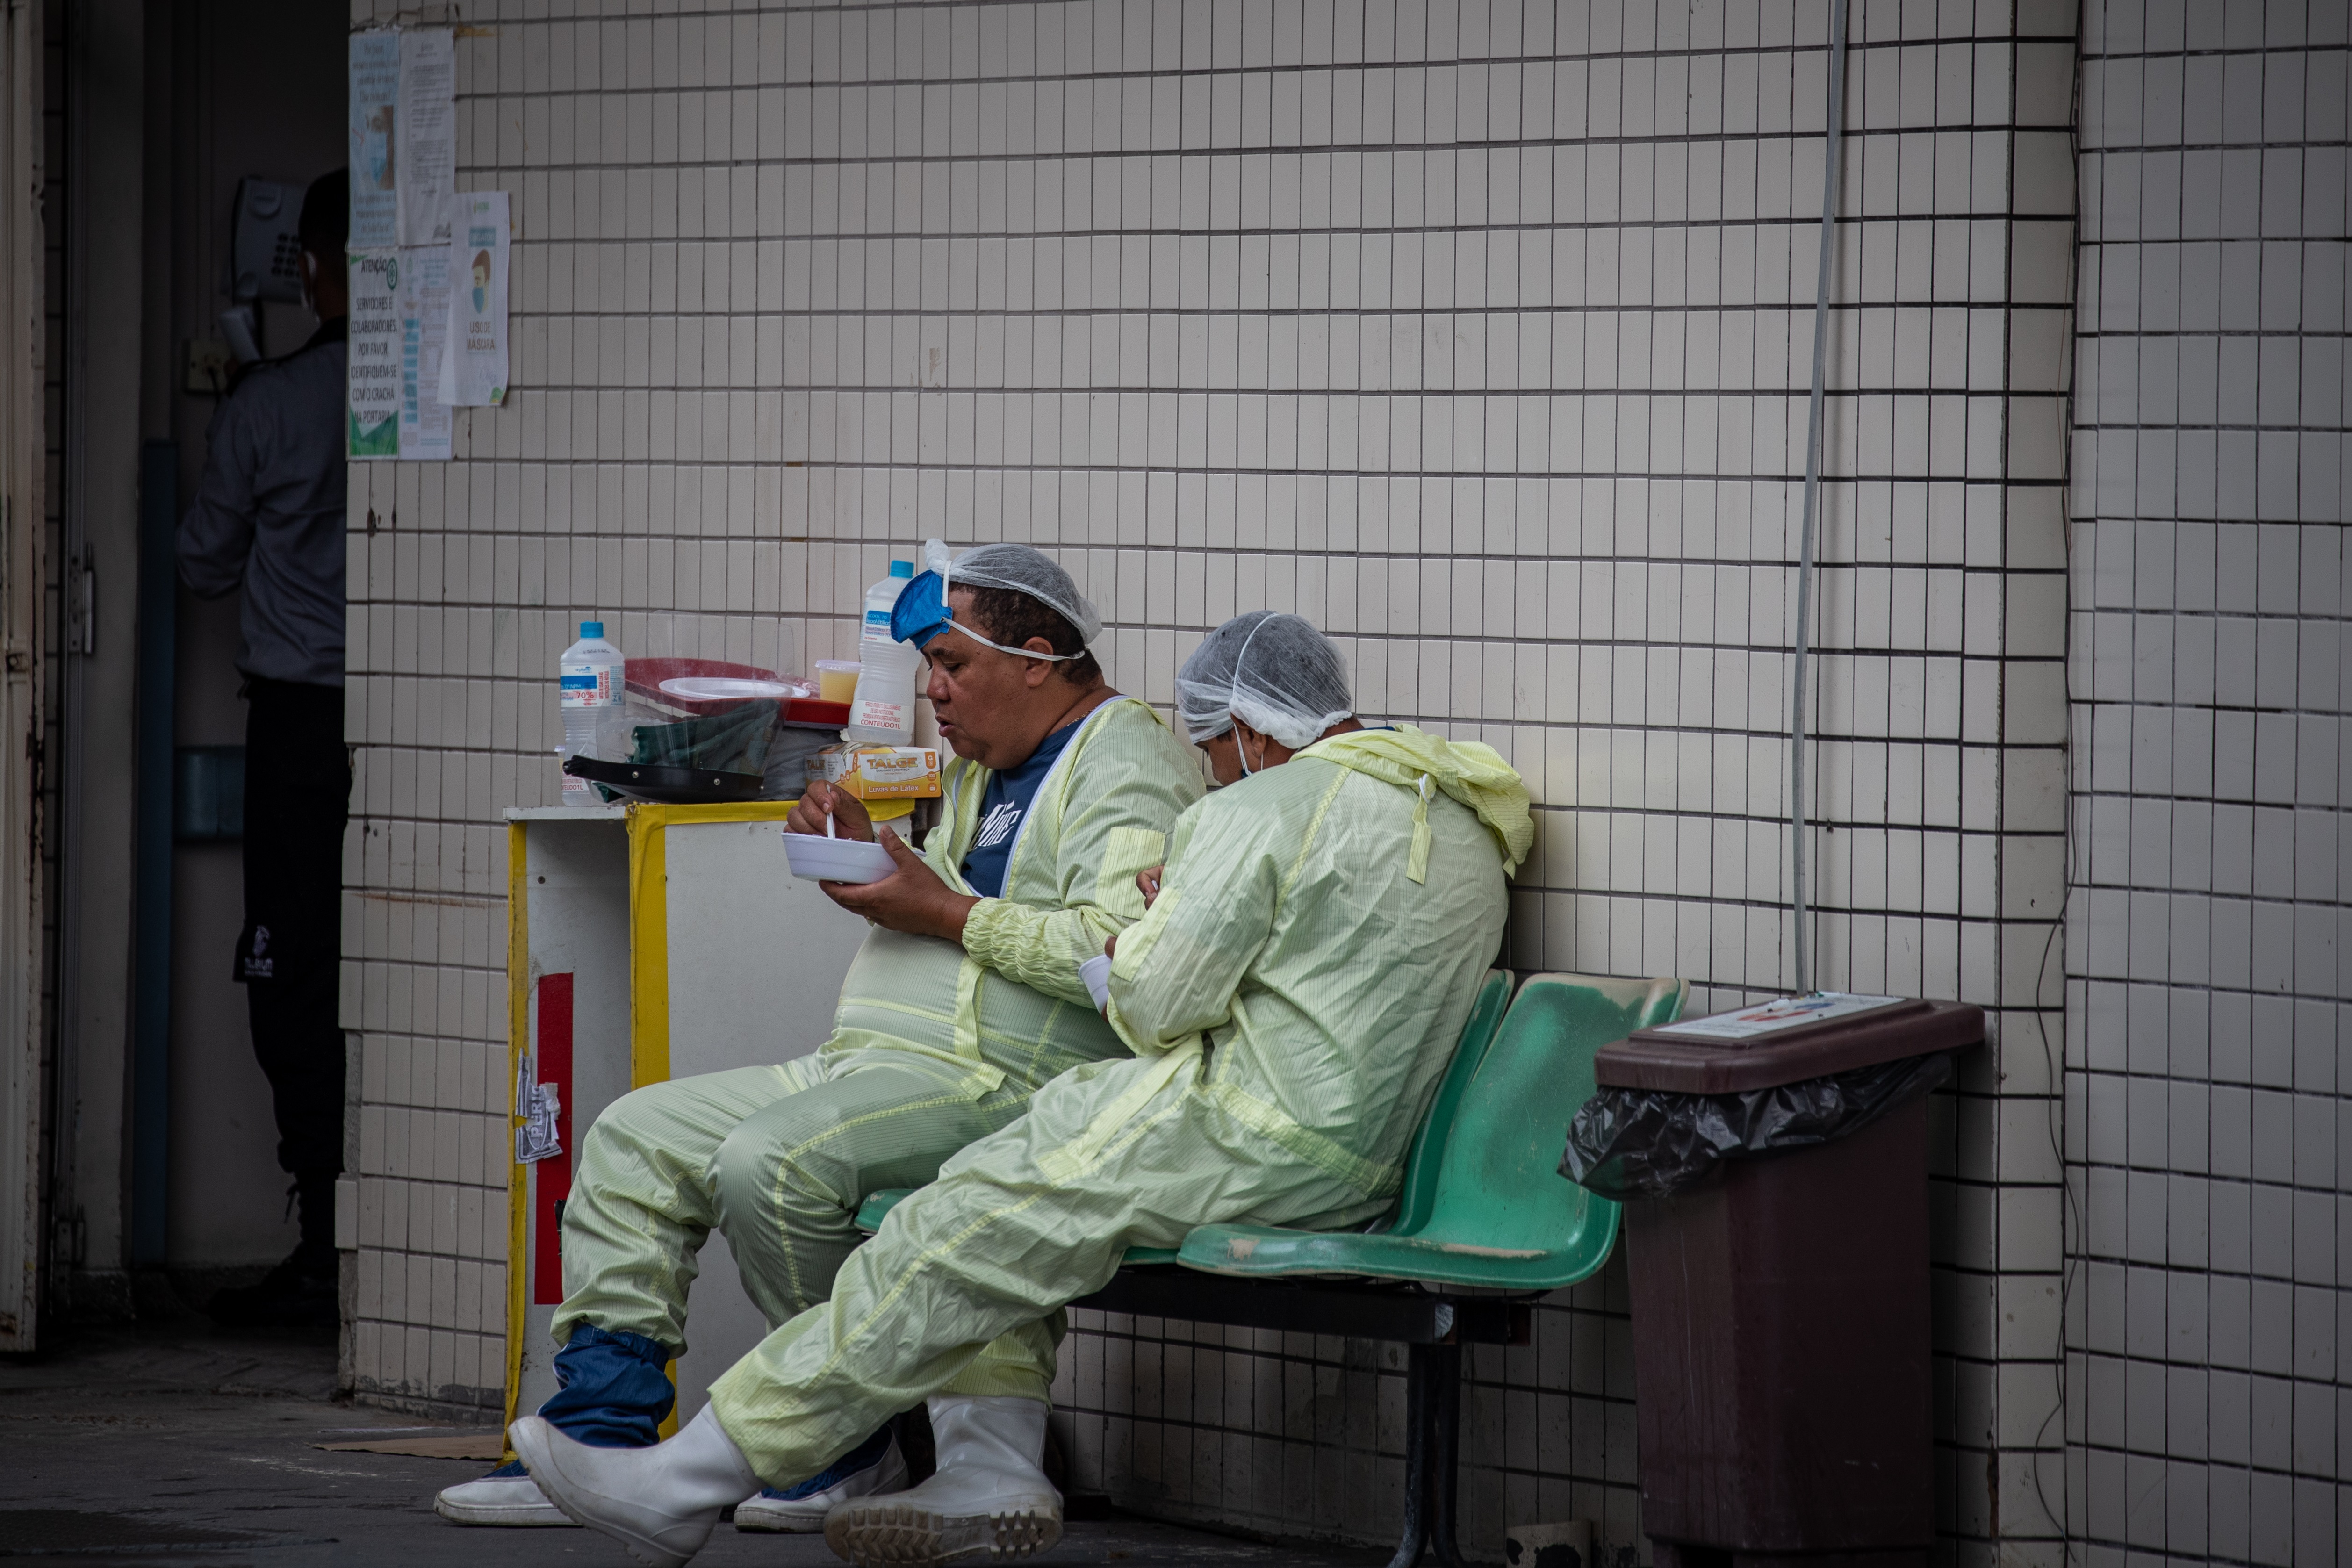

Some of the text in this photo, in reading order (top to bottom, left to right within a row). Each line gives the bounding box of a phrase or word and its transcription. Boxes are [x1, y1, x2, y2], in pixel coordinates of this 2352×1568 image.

[361, 256, 387, 275] ATENÇÃO
[356, 296, 392, 310] SERVIDORES E
[351, 319, 397, 334] COLABORADORES,
[469, 321, 490, 334] USO DE
[358, 342, 389, 357] POR FAVOR,
[467, 335, 496, 350] MÁSCARA
[351, 364, 397, 379] IDENTIFIQUEM-SE
[352, 384, 394, 401] COM O CRACHÁ
[355, 410, 391, 424] NA PORTARIA
[867, 757, 918, 770] TALGE
